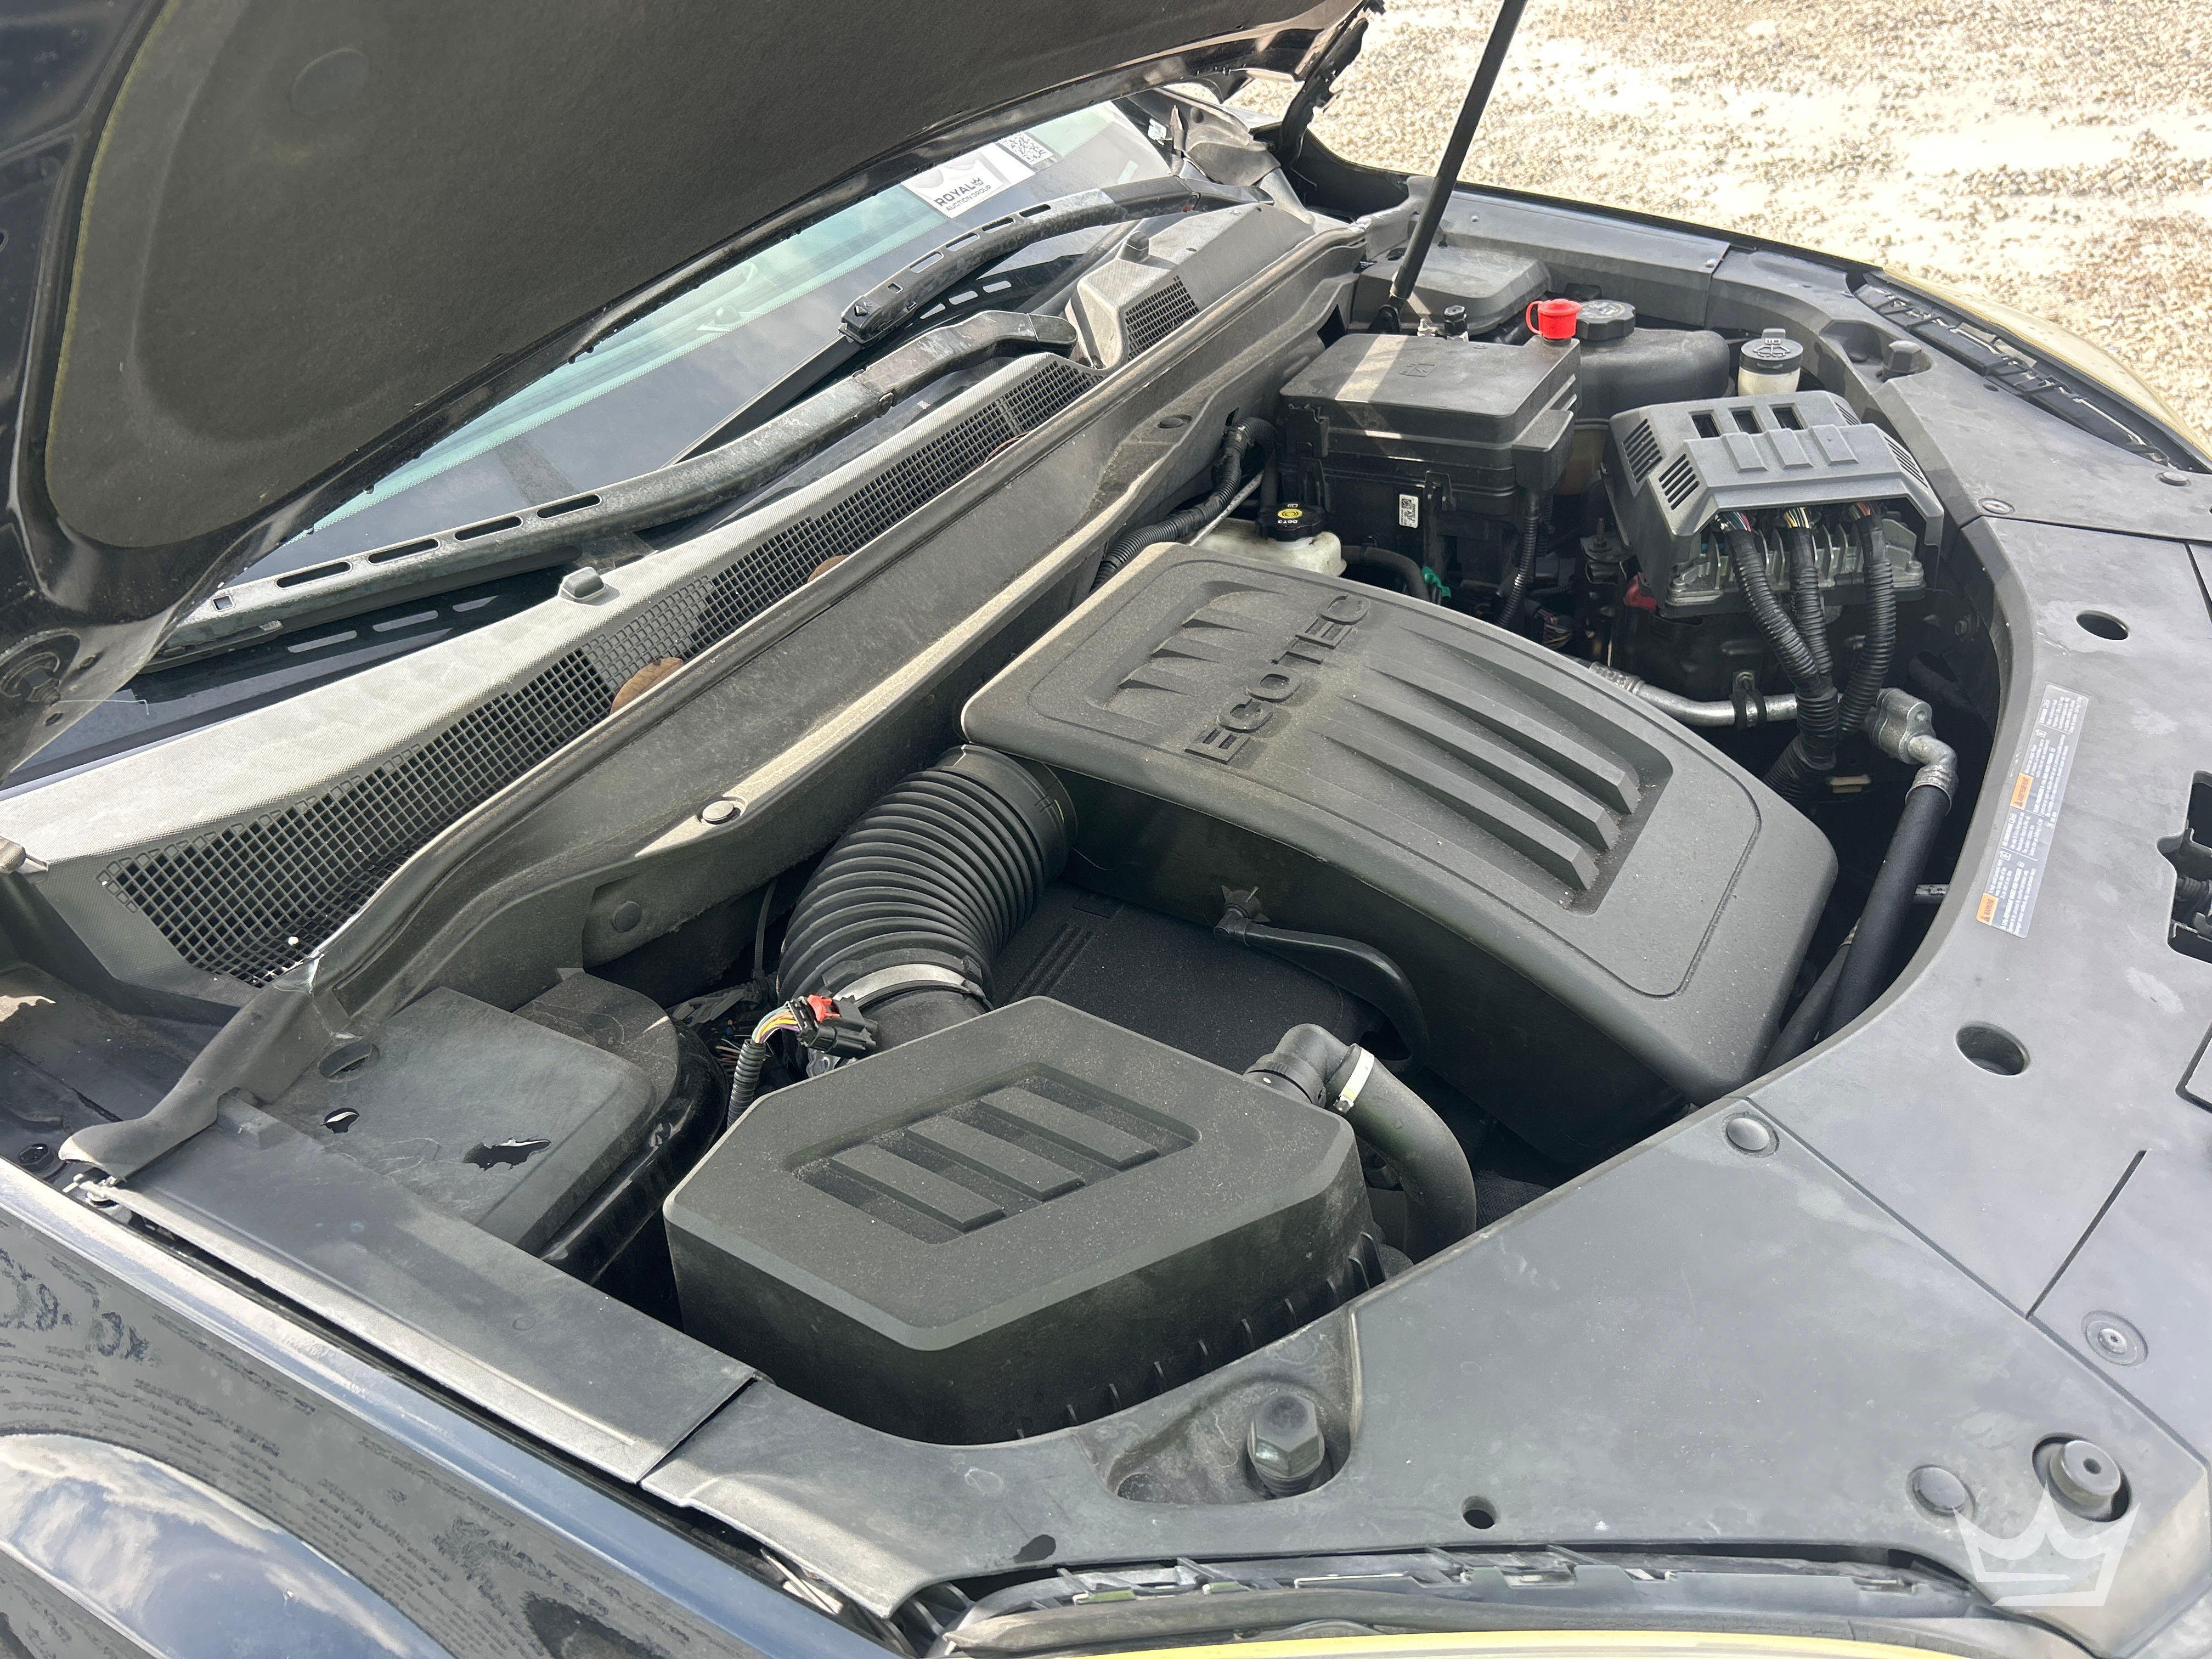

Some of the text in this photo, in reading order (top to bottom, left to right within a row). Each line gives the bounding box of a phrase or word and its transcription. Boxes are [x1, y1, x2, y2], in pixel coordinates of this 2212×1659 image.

[934, 183, 976, 206] ROYAL
[946, 196, 973, 211] AUCTION
[1184, 594, 1370, 765] ECOTEC
